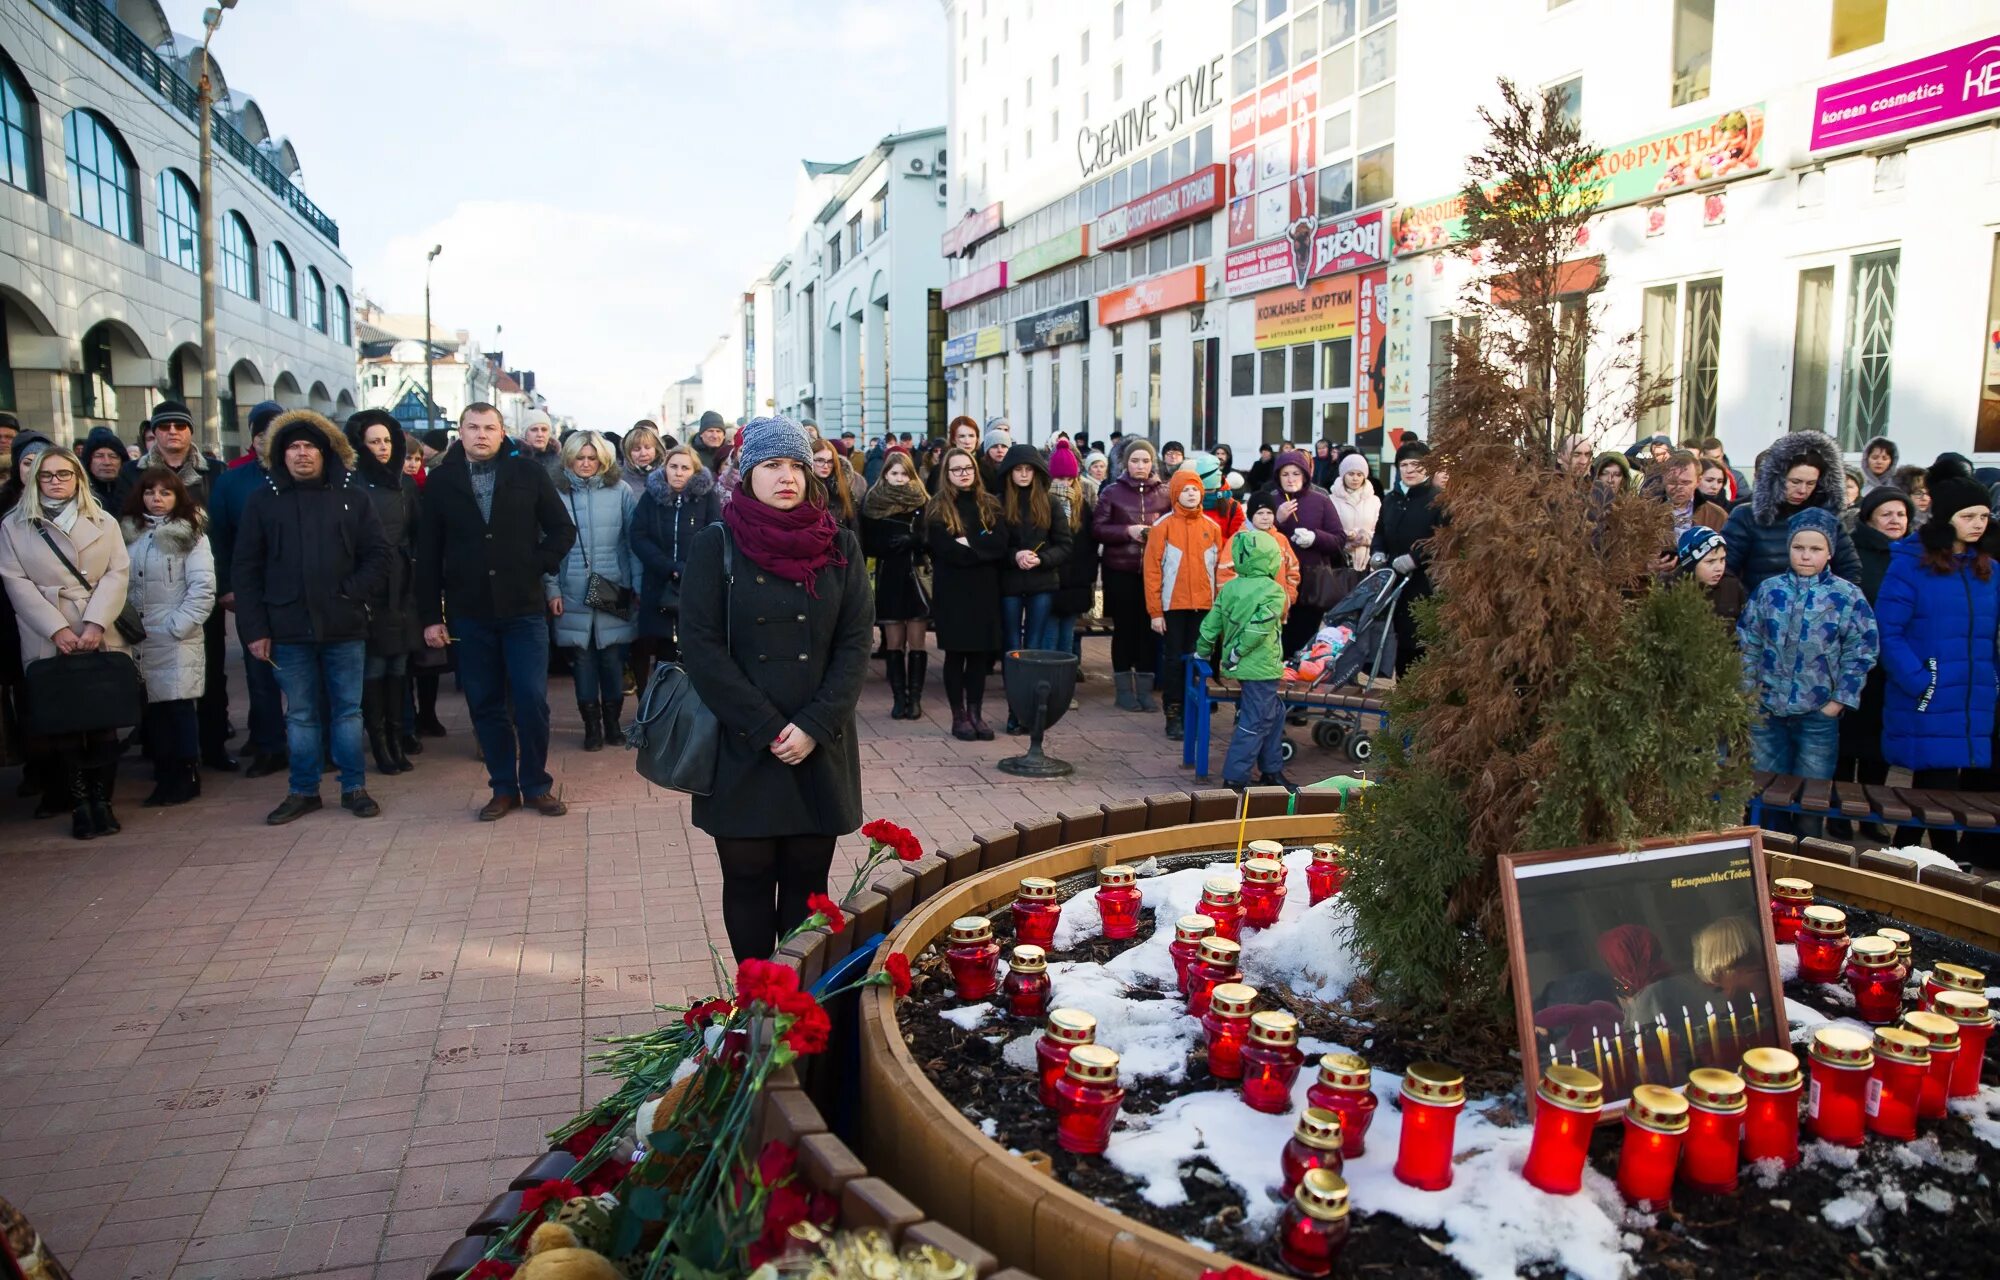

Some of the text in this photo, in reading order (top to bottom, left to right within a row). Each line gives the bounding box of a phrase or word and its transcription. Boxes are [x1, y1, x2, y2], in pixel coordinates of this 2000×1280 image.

[1078, 54, 1223, 178] CREATIVE STYLE
[1821, 83, 1944, 125] korean cosmetics
[1128, 173, 1215, 231] СПОРТ ОТДЫХ ТУРИЗМ
[1315, 221, 1381, 274] БИЗОН
[1257, 299, 1306, 321] КОЖАНЫЕ
[1312, 289, 1353, 312] КУРТКИ
[1917, 699, 1929, 712] LOVE
[1671, 868, 1751, 889] #КемеровоМыСТобой
